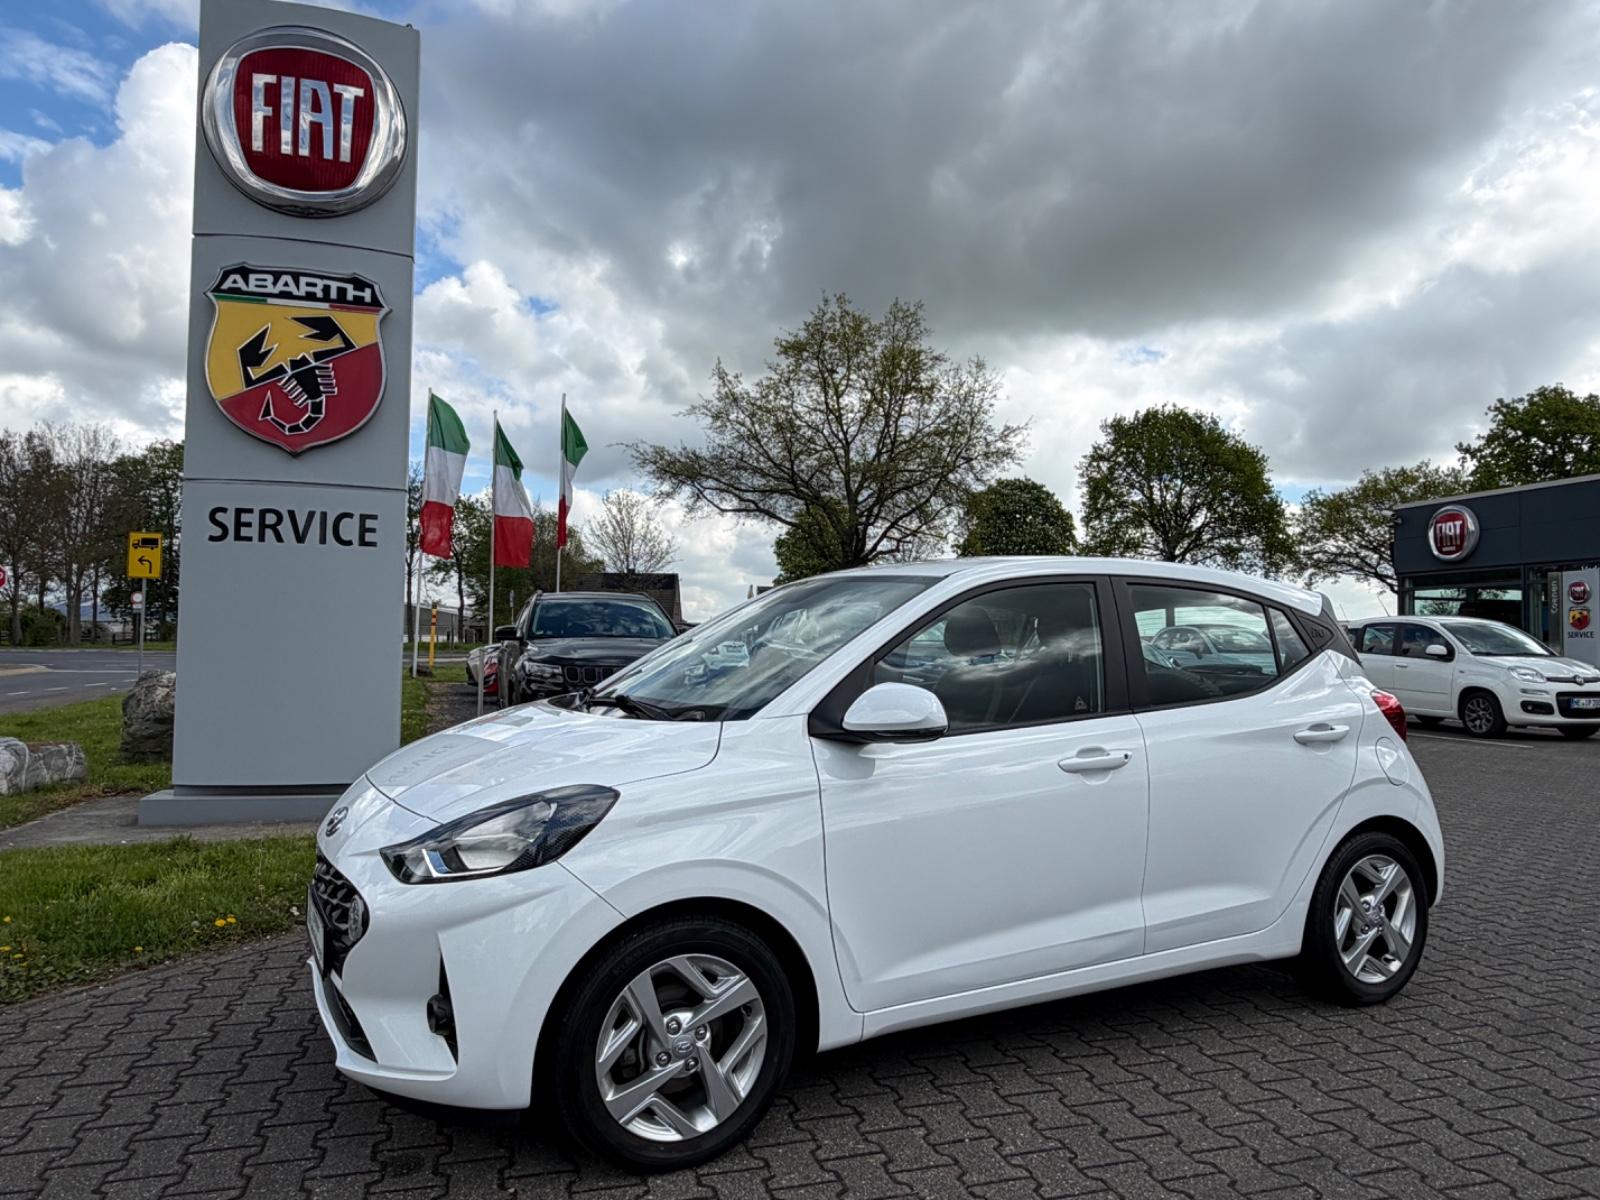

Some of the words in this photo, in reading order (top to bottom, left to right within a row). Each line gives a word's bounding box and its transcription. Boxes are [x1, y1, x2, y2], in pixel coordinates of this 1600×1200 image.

[251, 72, 364, 163] FIAT
[220, 273, 372, 303] ABARTH
[207, 506, 379, 547] SERVICE
[1436, 520, 1463, 546] FIAT
[1568, 631, 1595, 639] SERVICE
